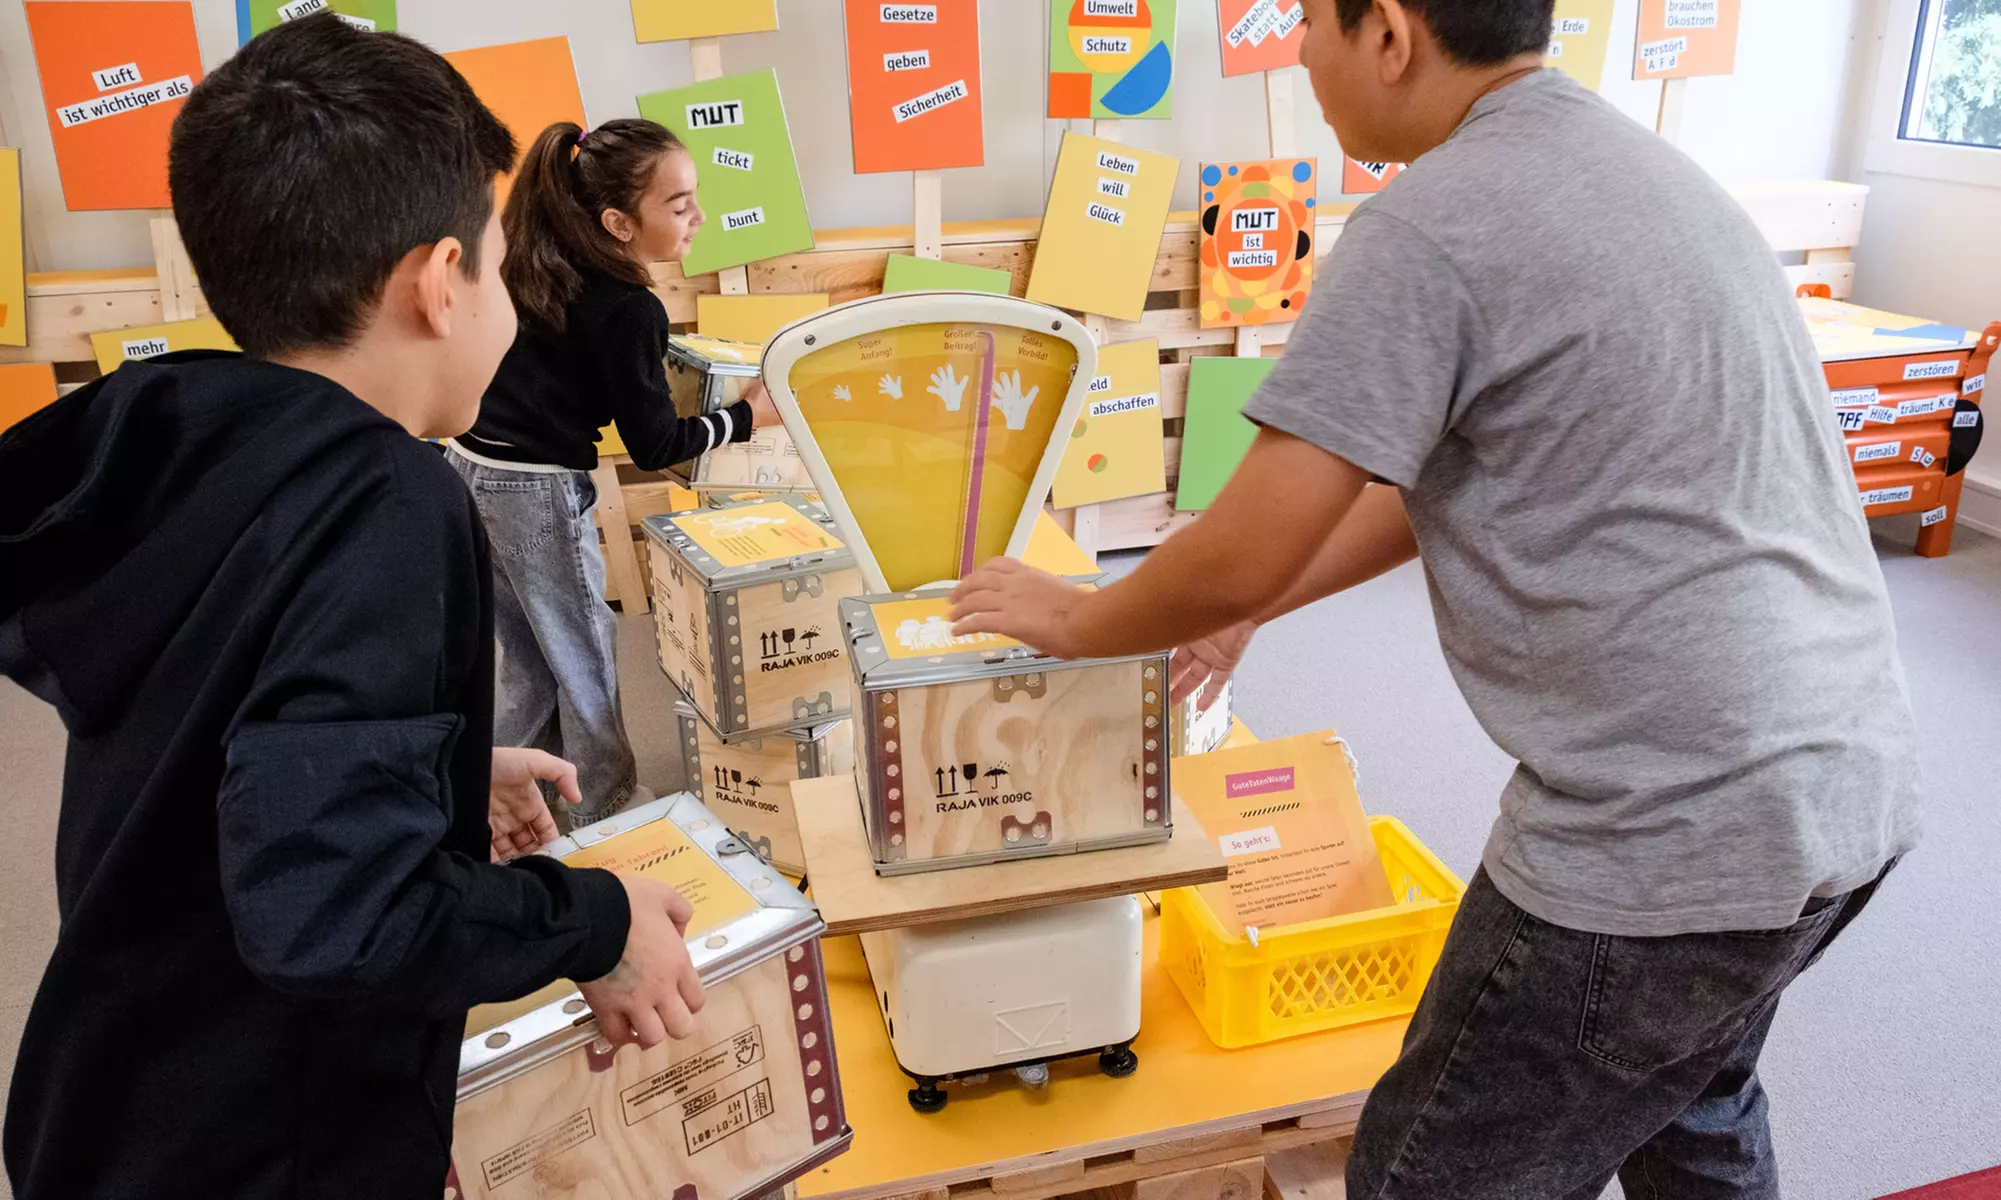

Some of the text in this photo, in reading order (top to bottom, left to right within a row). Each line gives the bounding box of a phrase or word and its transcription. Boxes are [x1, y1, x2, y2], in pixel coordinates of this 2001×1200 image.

[1088, 0, 1134, 15] Umwelt
[1668, 0, 1714, 11] brauchen
[883, 7, 934, 21] Gesetze
[1254, 13, 1278, 41] statt
[1279, 8, 1303, 35] Auto
[1562, 20, 1585, 32] Erde
[1086, 38, 1127, 52] Schutz
[887, 54, 927, 72] geben
[100, 67, 136, 88] Luft
[65, 81, 189, 124] ist wichtiger als
[899, 85, 962, 119] Sicherheit
[690, 103, 739, 127] MUT
[717, 151, 749, 168] tickt
[1099, 154, 1135, 173] Leben
[1102, 182, 1124, 196] will
[728, 211, 759, 228] bunt
[1089, 204, 1121, 224] Glück
[1235, 211, 1276, 229] MUT
[1245, 236, 1261, 248] ist
[1232, 252, 1273, 266] wichtig
[944, 330, 973, 338] Großer
[127, 340, 165, 356] mehr
[858, 339, 882, 350] Super
[944, 340, 977, 351] Beitrag!
[1022, 335, 1044, 348] Tolles
[860, 348, 893, 361] Anfang!
[1018, 346, 1048, 361] Vorbild!
[1908, 363, 1954, 377] zerstören
[1088, 378, 1108, 391] eld
[1965, 378, 1984, 392] wir
[1833, 392, 1876, 405] niemand
[1093, 396, 1154, 416] abschaffen
[1900, 401, 1934, 414] träumt
[1870, 408, 1893, 421] Hilfe
[1956, 413, 1975, 425] alle
[1858, 445, 1897, 459] niemals
[1868, 490, 1909, 503] träumen
[1925, 509, 1944, 524] soll
[761, 649, 840, 672] RAJA VIK 009C
[1231, 774, 1291, 791] GuteTatenWaage
[716, 791, 779, 813] RAJA VIK 009C
[936, 791, 1032, 813] RAJA VIK 009C
[1231, 840, 1242, 850] So
[727, 1100, 740, 1115] HT
